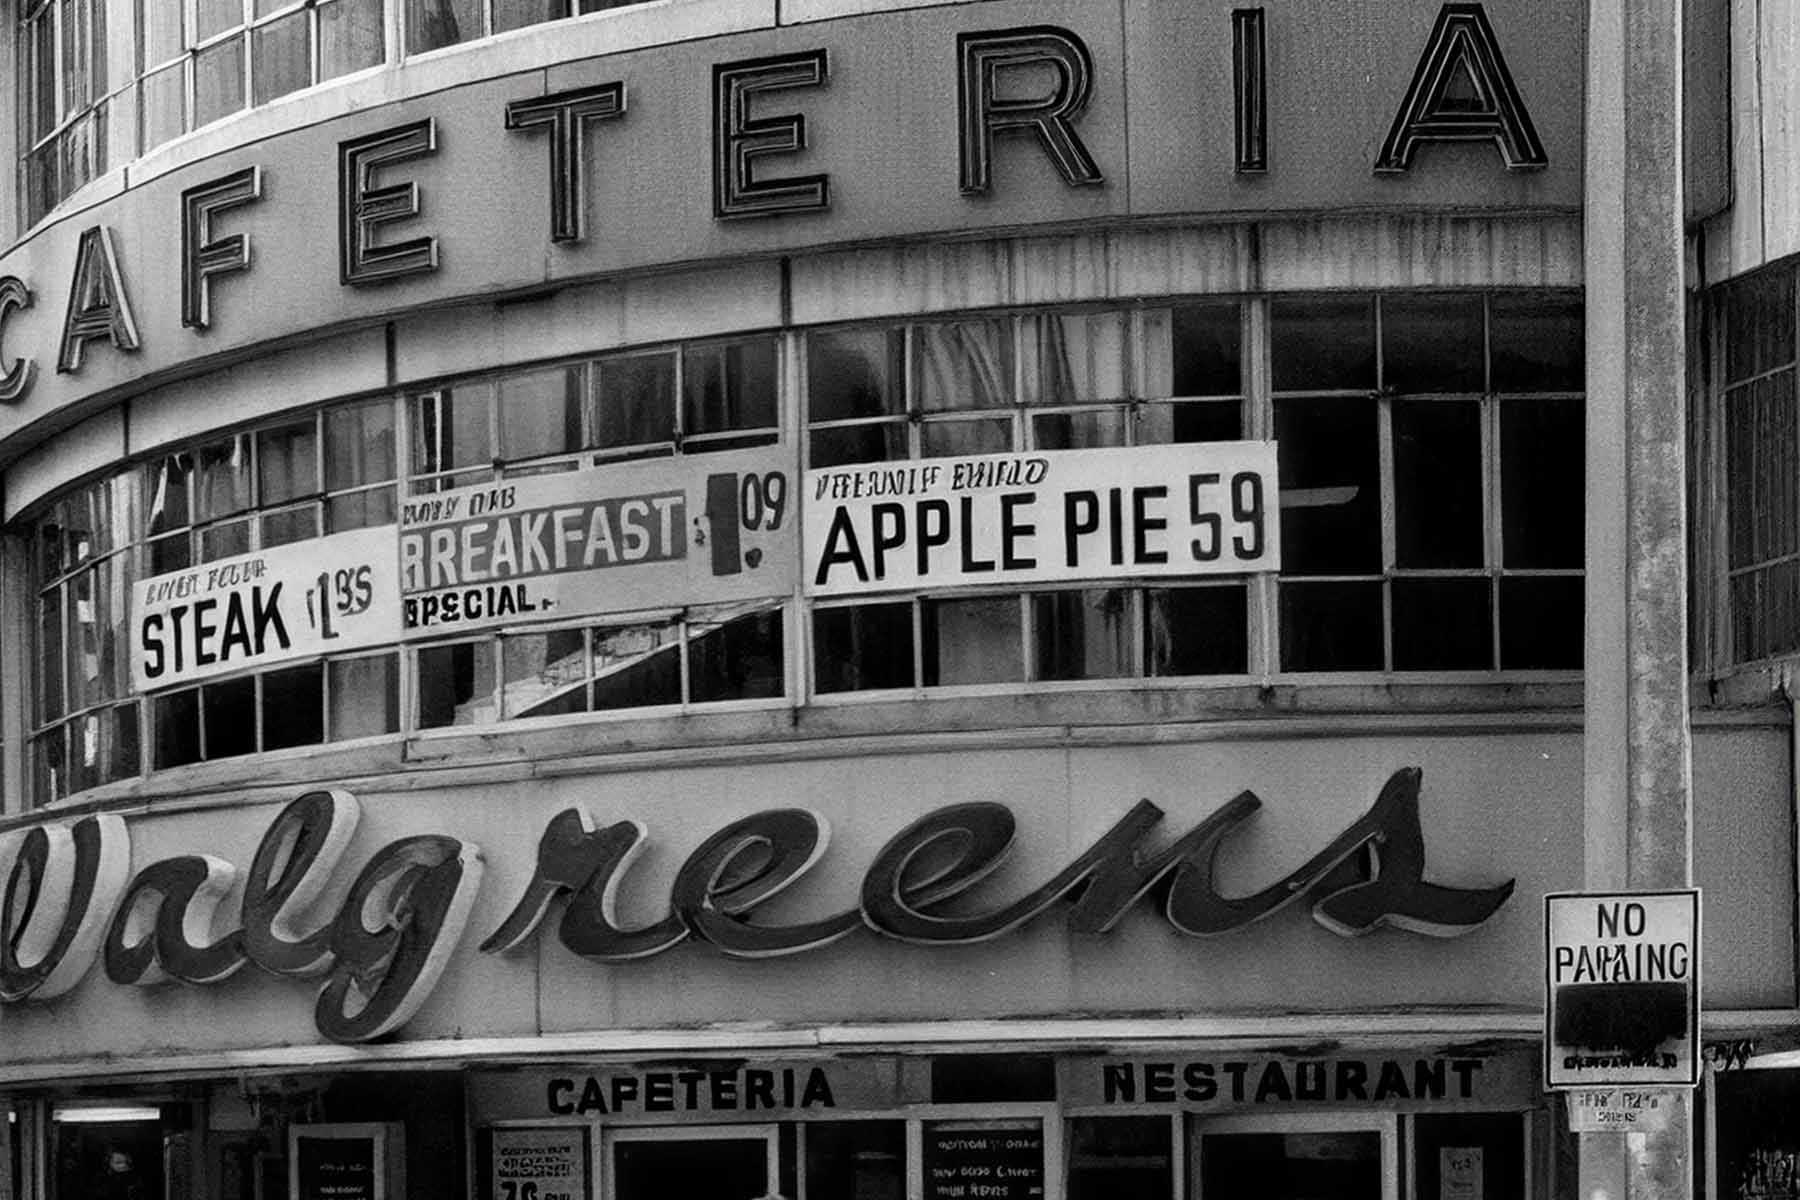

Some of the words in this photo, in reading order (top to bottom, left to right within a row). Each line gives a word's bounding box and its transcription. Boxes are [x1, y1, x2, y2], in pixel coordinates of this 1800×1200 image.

[815, 493, 1038, 585] APPLE
[1064, 486, 1168, 567] PIE
[1188, 471, 1265, 561] 59
[142, 581, 291, 678] STEAK
[1598, 903, 1646, 937] NO
